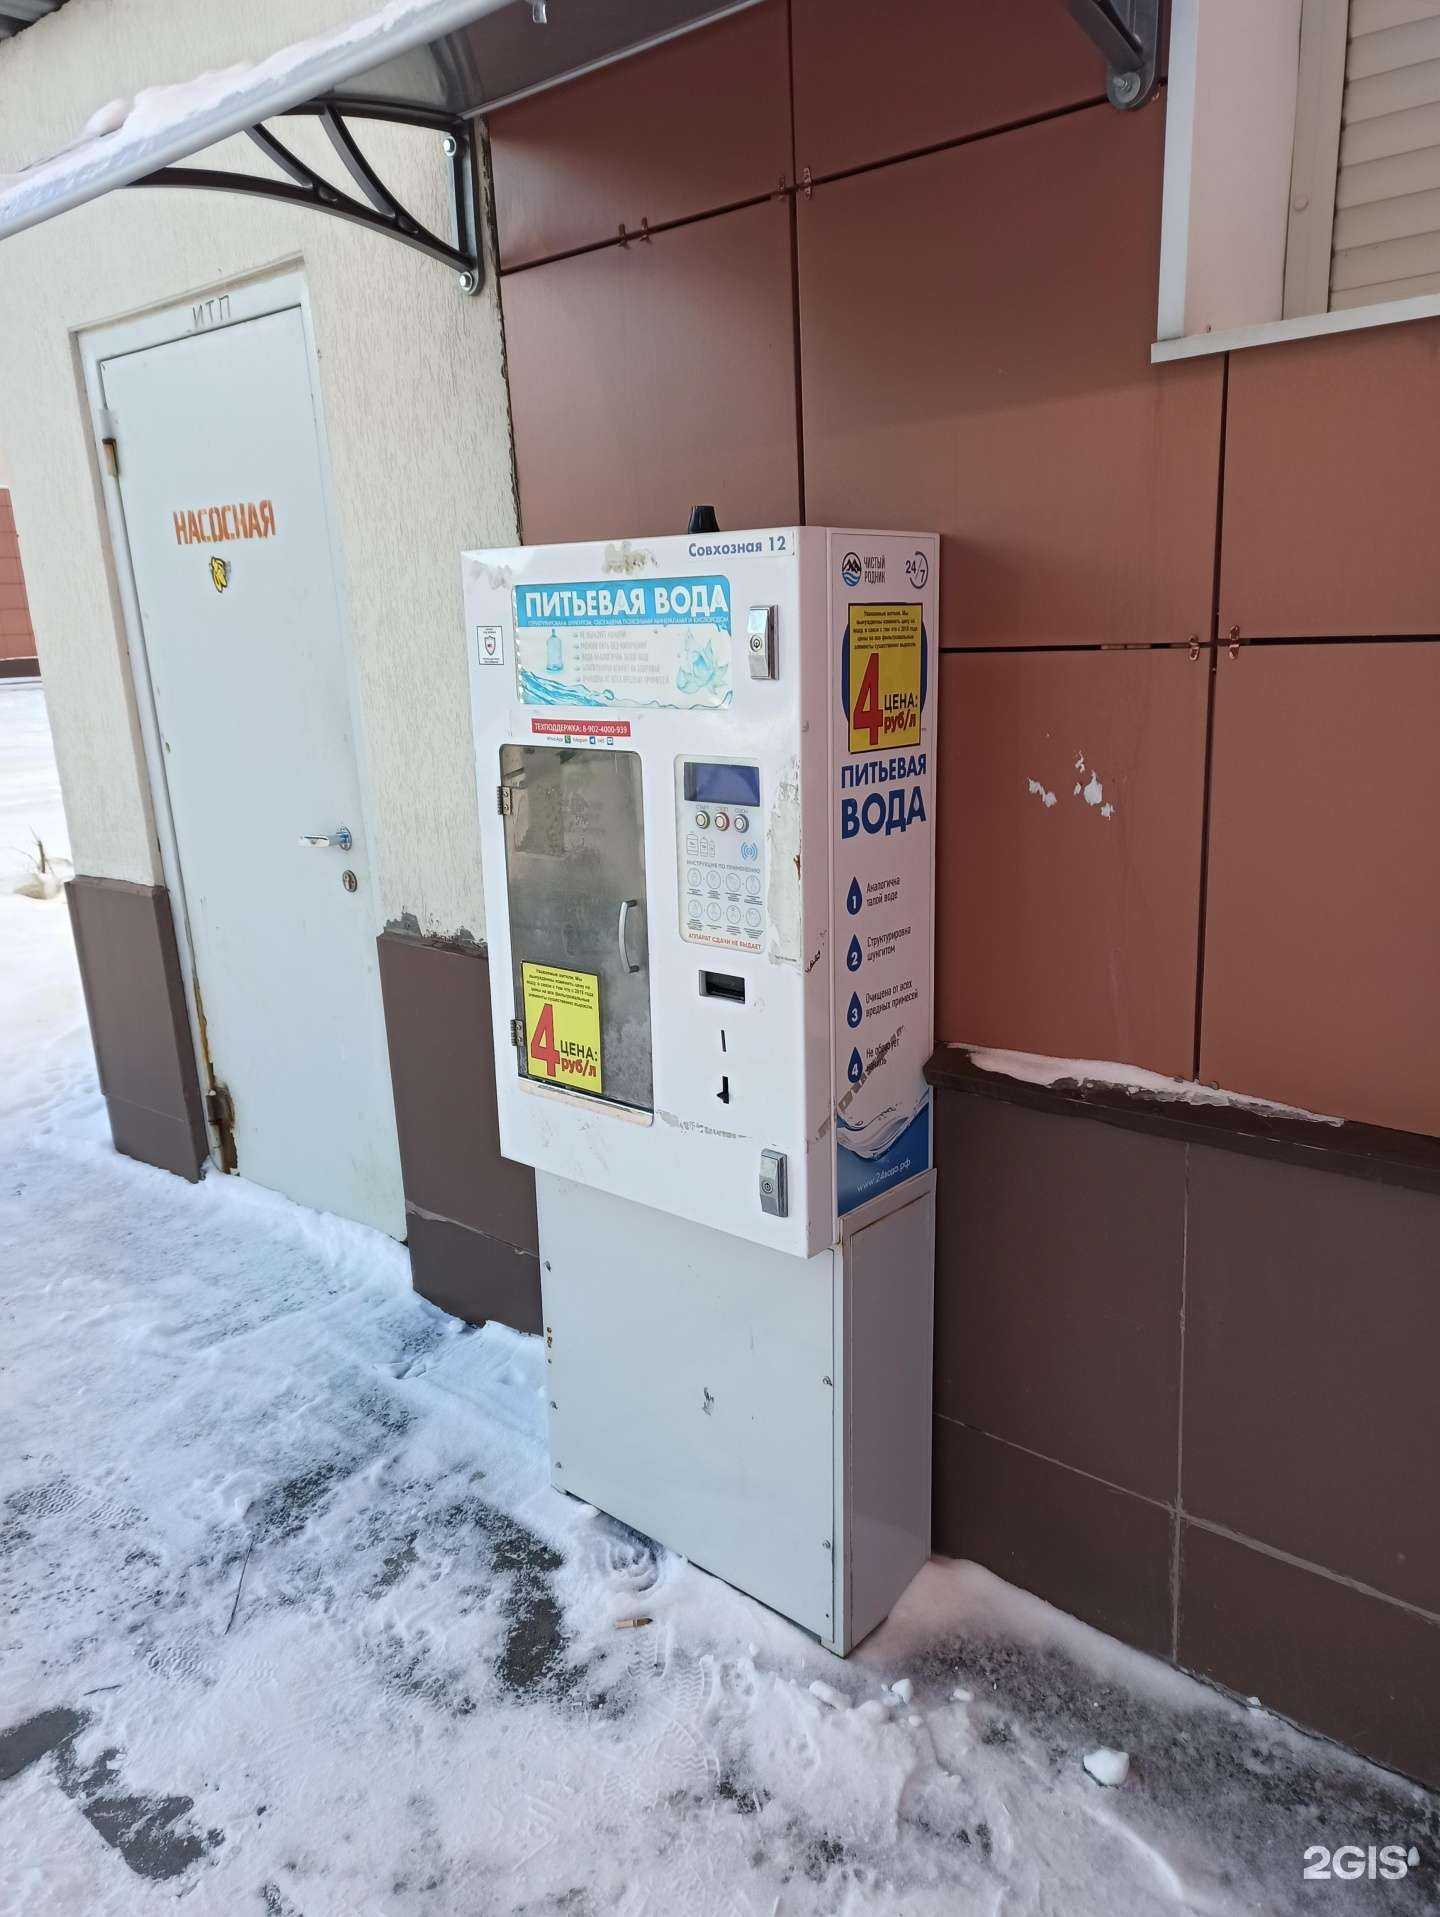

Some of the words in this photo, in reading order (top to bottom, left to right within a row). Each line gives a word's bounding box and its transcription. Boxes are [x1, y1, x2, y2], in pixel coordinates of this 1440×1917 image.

[192, 294, 230, 328] ИТП
[173, 499, 276, 545] НАСОСНАЯ
[688, 542, 763, 557] Совхозная
[768, 535, 786, 551] 12
[863, 554, 886, 569] ЧИСТЫЙ
[864, 570, 886, 584] РОДНИК
[525, 588, 646, 618] ПИТЬЕВАЯ
[654, 584, 729, 617] ВОДА
[853, 652, 884, 746] 4
[884, 693, 918, 712] ЦЕНА:
[535, 722, 582, 733] ТЕХПОДДЕРЖКА:
[883, 710, 917, 734] руб/л
[841, 753, 927, 788] ПИТЬЕВАЯ
[841, 785, 927, 840] ВОДА
[852, 895, 857, 909] 1
[866, 876, 901, 894] Аналогична
[866, 893, 883, 907] талой
[883, 891, 898, 903] воде
[688, 933, 711, 942] АППАРАТ
[711, 936, 731, 945] СДАЧИ
[740, 941, 761, 950] ВЫДАЕТ
[867, 945, 896, 962] шунгитом
[851, 951, 858, 966] 2
[851, 1007, 858, 1022] 3
[865, 988, 891, 1004] Очищена
[892, 984, 899, 994] от
[900, 980, 913, 992] всех
[865, 1000, 891, 1018] вредных
[891, 988, 919, 1008] примесей
[531, 1003, 560, 1077] 4
[560, 1040, 598, 1062] ЦЕНА:
[560, 1057, 597, 1078] руб/л
[851, 1063, 858, 1077] 4
[866, 1047, 874, 1059] Не
